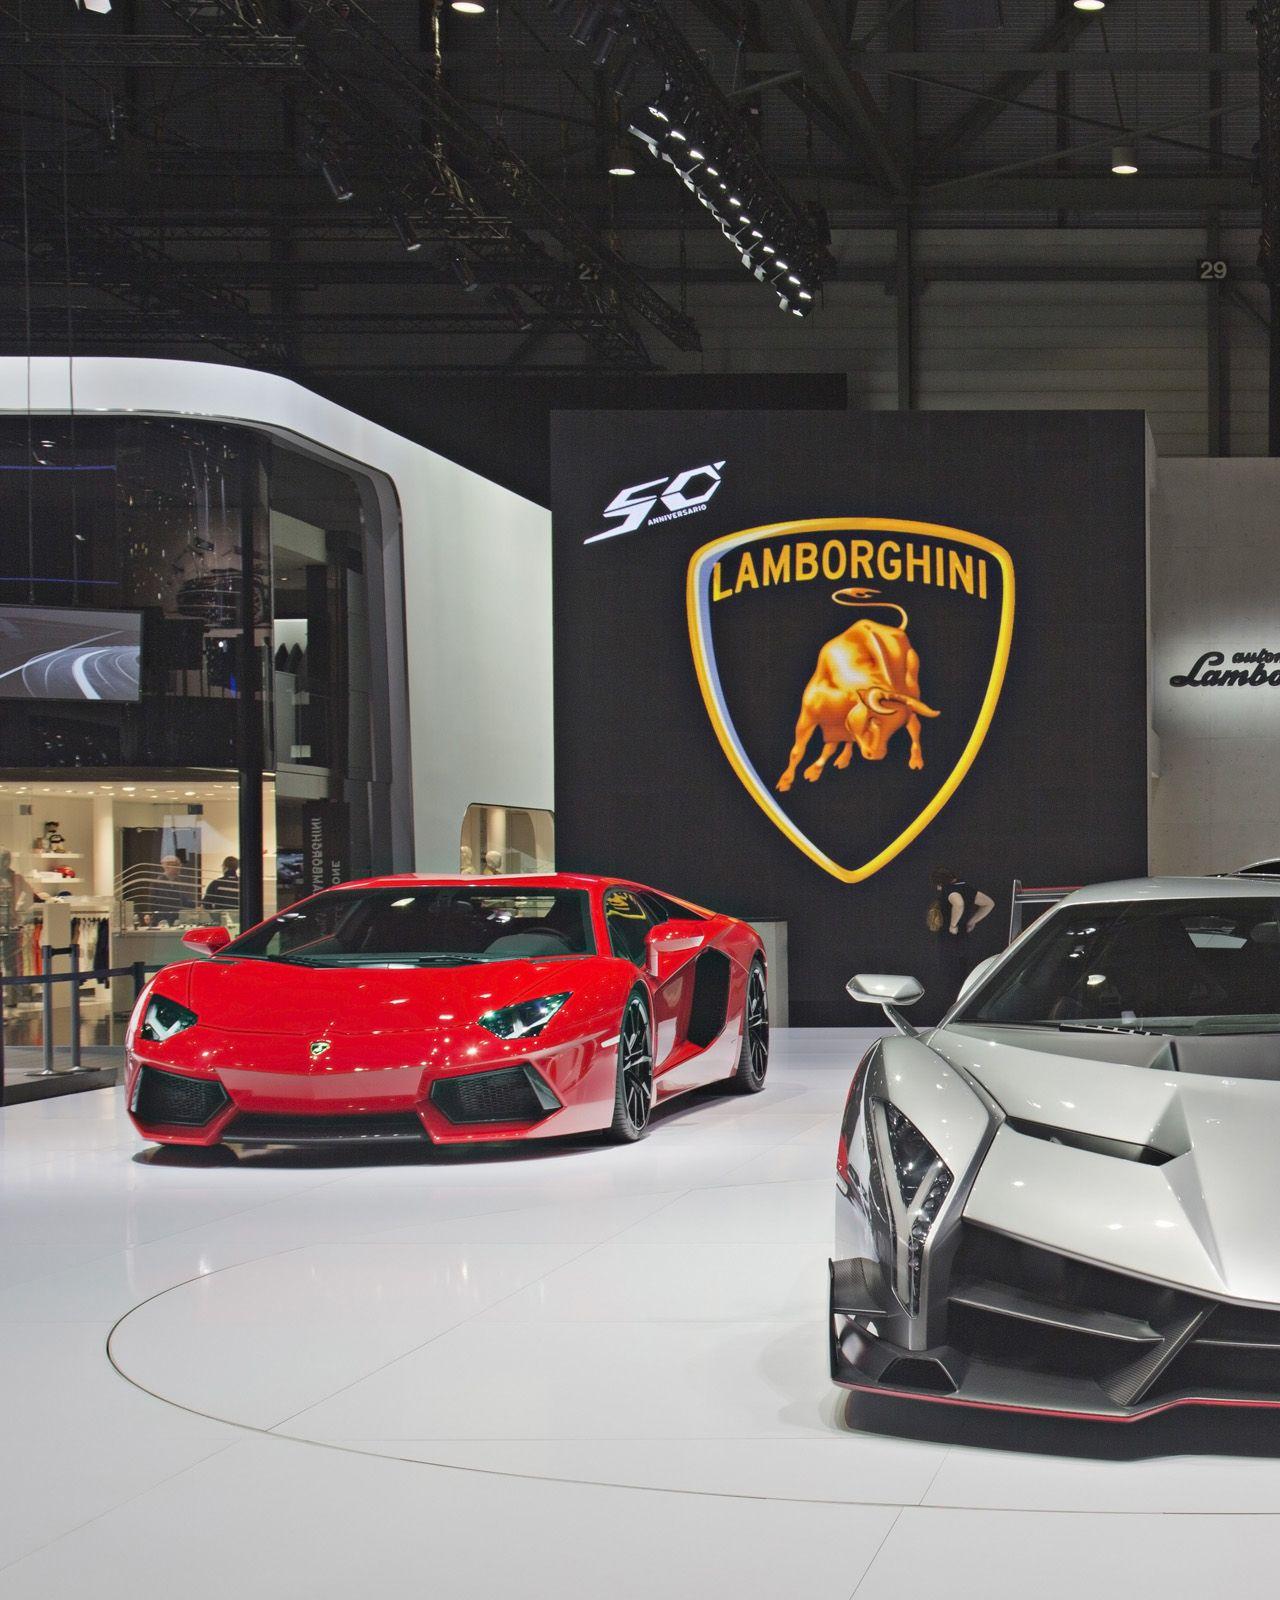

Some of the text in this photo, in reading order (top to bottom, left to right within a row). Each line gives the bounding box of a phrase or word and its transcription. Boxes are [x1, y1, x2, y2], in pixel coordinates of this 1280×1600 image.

[1200, 261, 1227, 279] 29
[647, 504, 708, 526] ANNIVERSARIO
[712, 539, 987, 602] LAMBORGHINI
